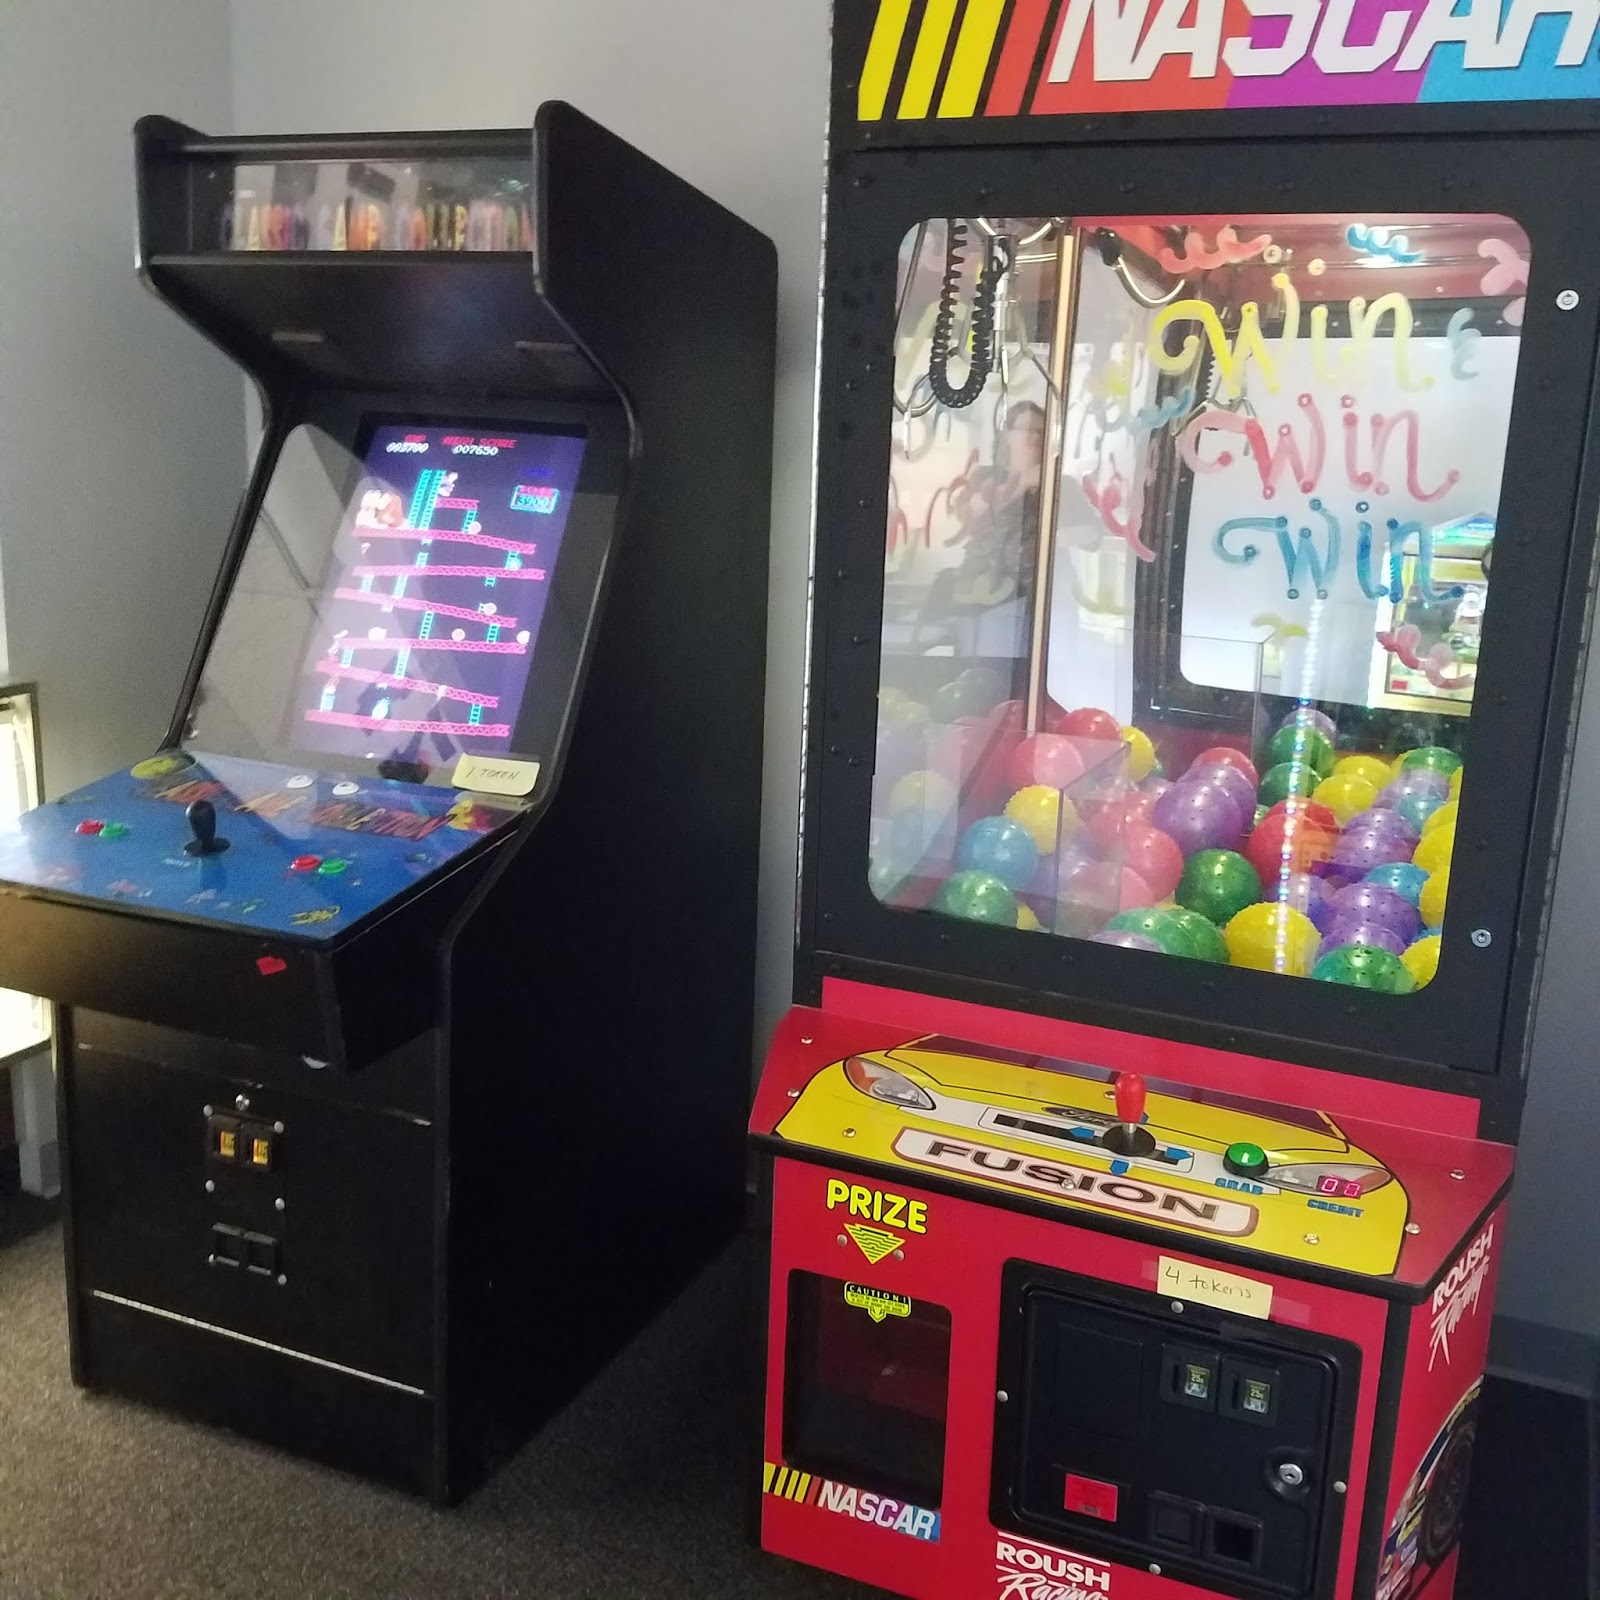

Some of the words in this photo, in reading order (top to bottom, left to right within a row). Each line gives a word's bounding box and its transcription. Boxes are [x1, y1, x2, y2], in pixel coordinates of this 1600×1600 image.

[826, 1178, 928, 1234] PRIZE
[927, 1139, 1219, 1222] FUSION
[1214, 1177, 1265, 1195] GRAB
[1307, 1199, 1364, 1218] CREDIT
[1165, 1265, 1180, 1285] 4
[1432, 1223, 1494, 1315] ROUSH
[818, 1480, 936, 1540] NASCAR
[996, 1541, 1111, 1592] ROUSH
